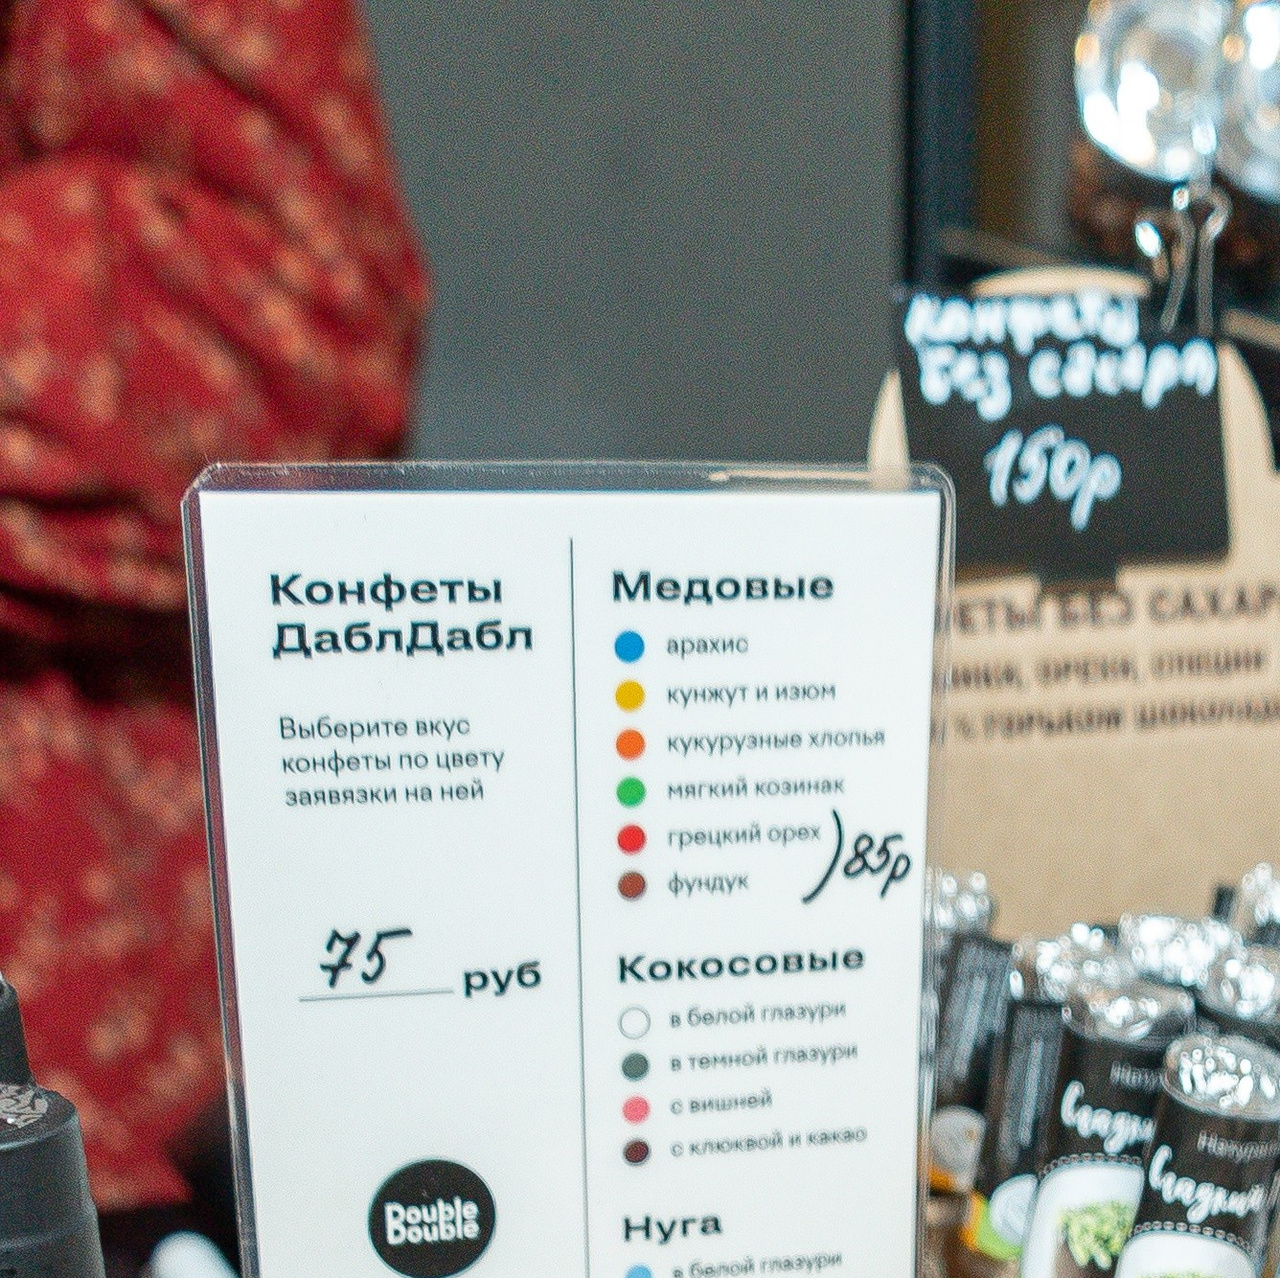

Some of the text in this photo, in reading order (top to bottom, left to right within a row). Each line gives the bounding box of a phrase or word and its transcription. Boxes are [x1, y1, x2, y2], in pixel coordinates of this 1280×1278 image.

[271, 573, 501, 611] Конфеты
[613, 571, 833, 605] Медовые
[272, 620, 532, 659] ДаблДабл
[667, 638, 748, 659] арахис
[668, 685, 835, 709] кунжут и изюм
[279, 716, 469, 743] Выберите вкус
[668, 731, 885, 756] кукурузные хлопья
[282, 750, 504, 777] конфеты по цвету
[405, 787, 432, 801] на
[440, 780, 483, 800] ней
[668, 778, 843, 799] мягкий козинак
[668, 824, 820, 851] грецкий орех
[668, 872, 748, 897] фундук
[319, 925, 414, 991] 75
[619, 950, 864, 983] Кокосовые
[464, 961, 541, 998] руб
[670, 1004, 846, 1028] в белой глазури
[670, 1045, 858, 1071] в темной глазури
[670, 1089, 772, 1115] с вишней
[689, 1131, 783, 1155] клюквой
[807, 1129, 867, 1145] какао
[383, 1197, 480, 1226] Double
[385, 1217, 481, 1246] Double
[624, 1216, 722, 1245] Нуга
[760, 1254, 842, 1272] глазури
